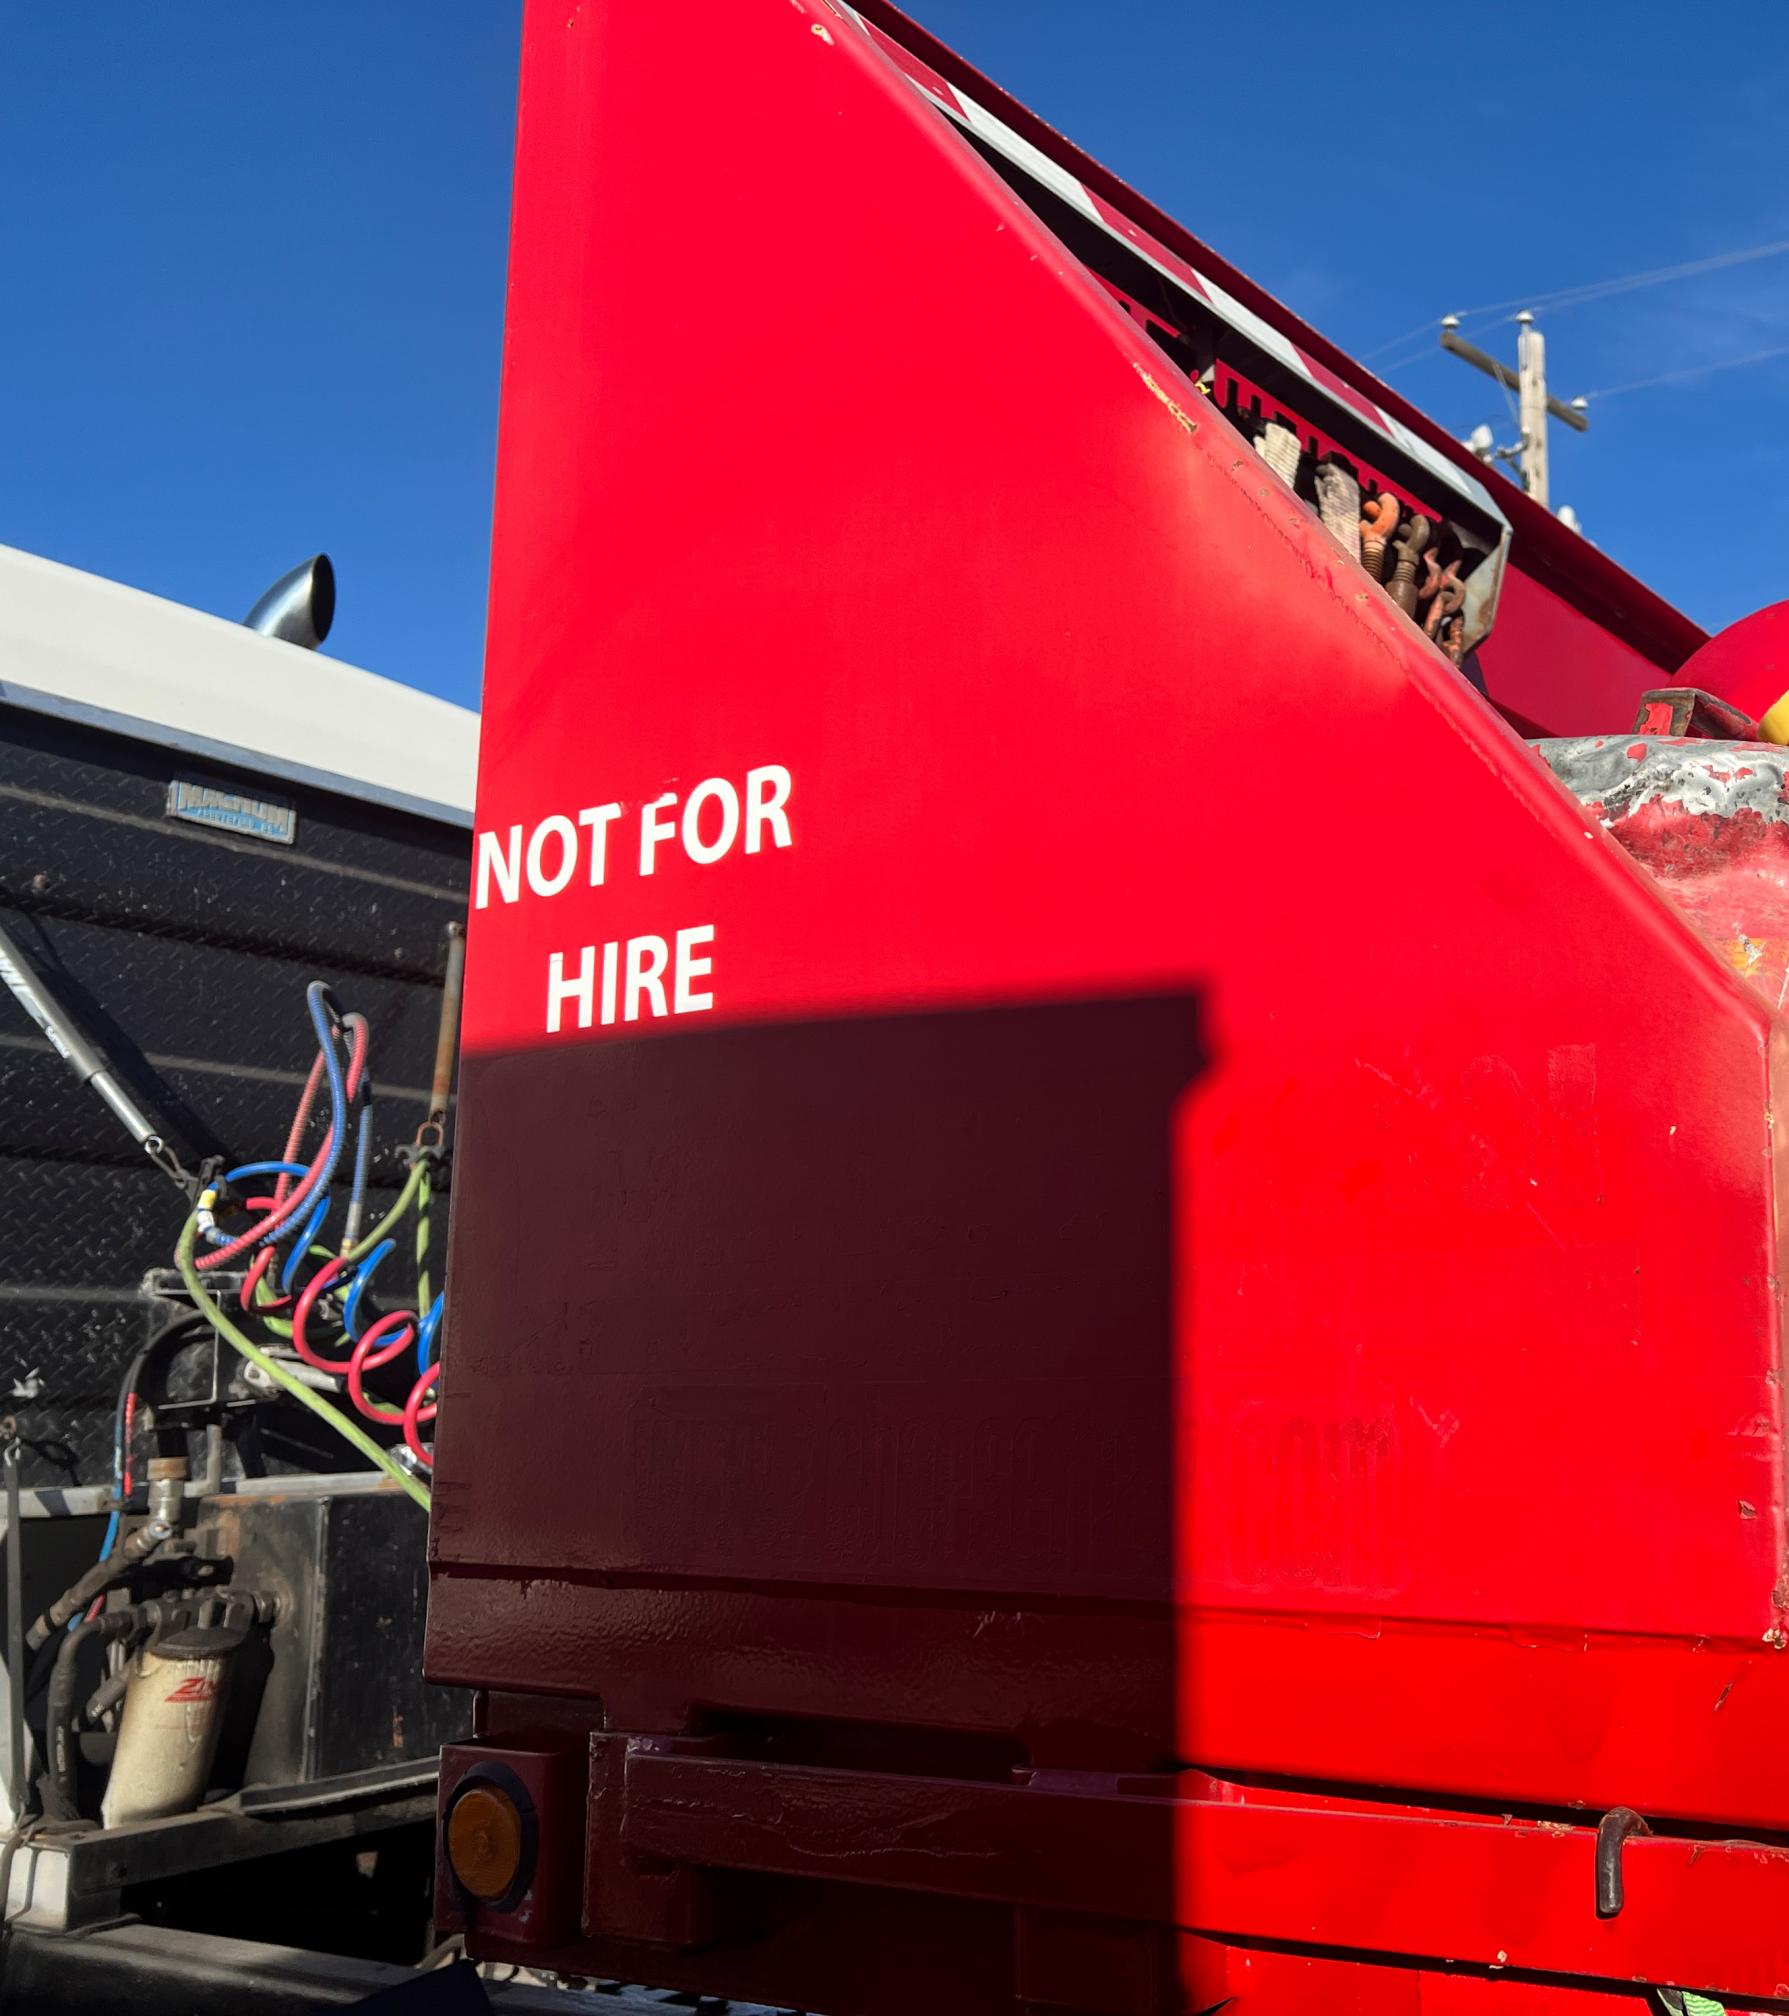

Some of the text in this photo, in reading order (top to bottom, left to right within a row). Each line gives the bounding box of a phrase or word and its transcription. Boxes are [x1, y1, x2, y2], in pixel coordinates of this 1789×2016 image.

[475, 765, 793, 909] NOT FOR
[546, 925, 715, 1034] HIRE
